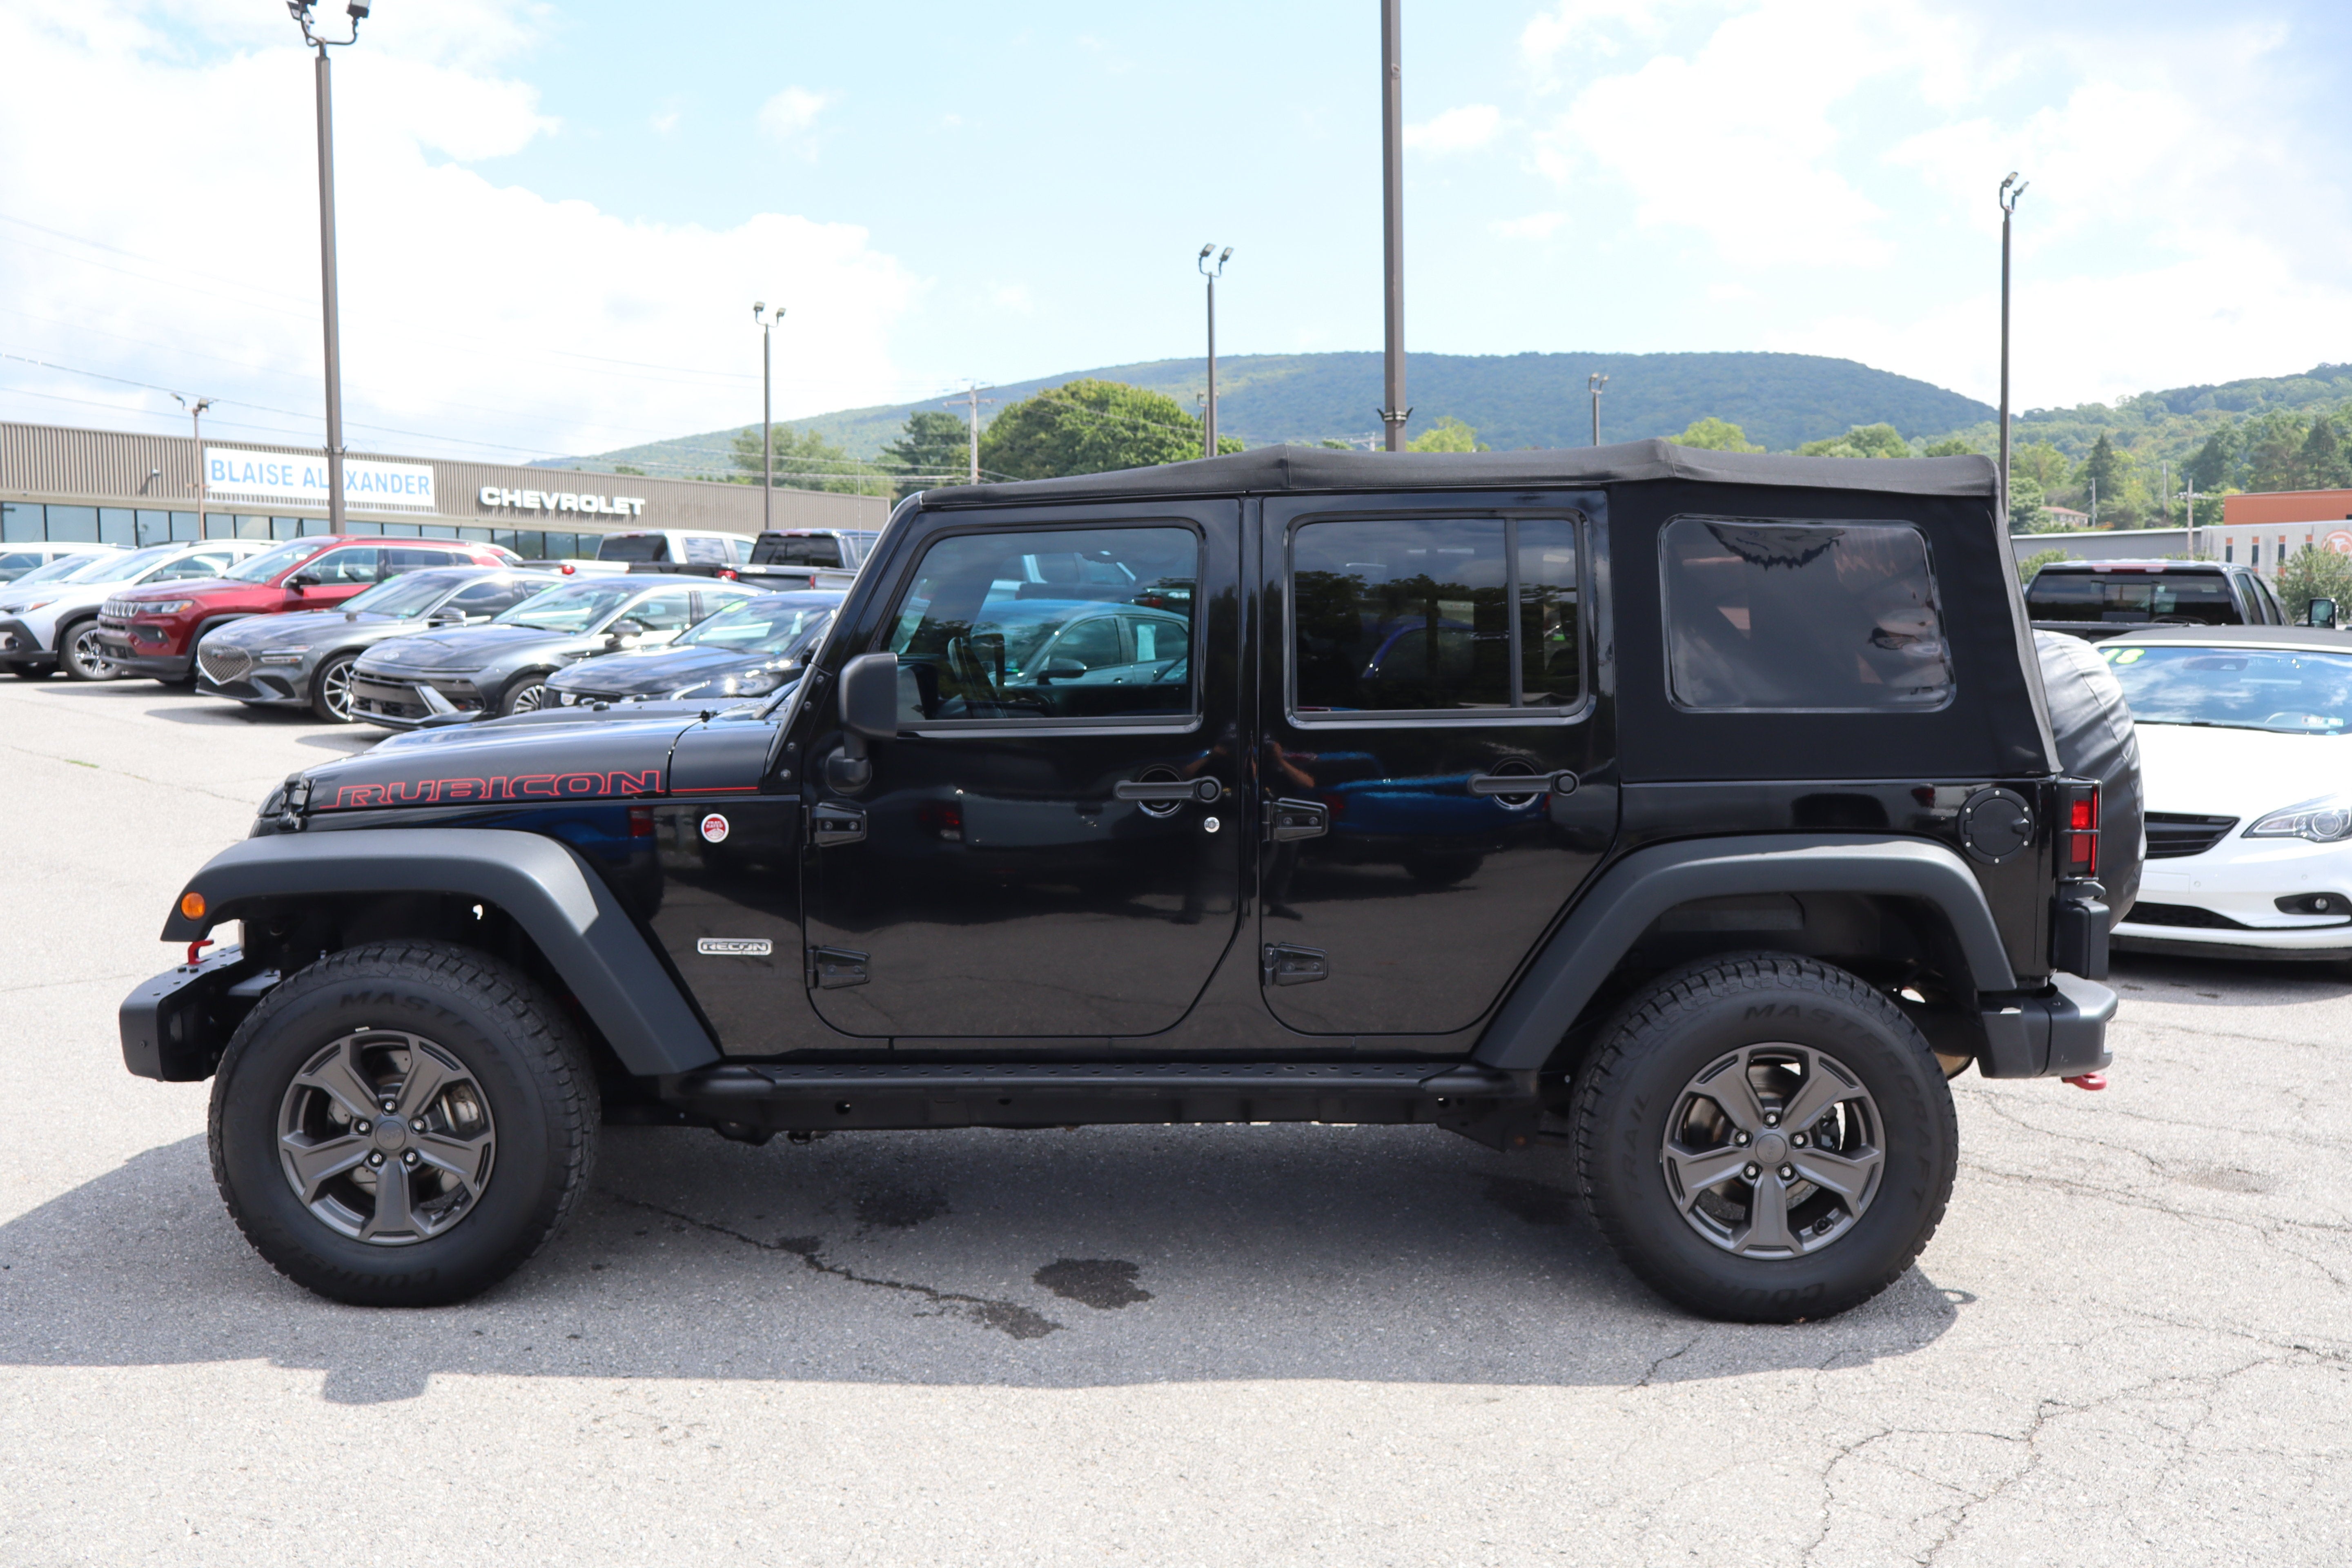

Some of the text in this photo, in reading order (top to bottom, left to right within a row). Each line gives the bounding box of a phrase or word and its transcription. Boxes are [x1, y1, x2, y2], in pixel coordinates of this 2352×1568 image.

[211, 459, 430, 495] BLAISE ALXANDER
[480, 486, 646, 516] CHEVROLET
[320, 770, 663, 808] RUBICON
[702, 942, 767, 951] RECON
